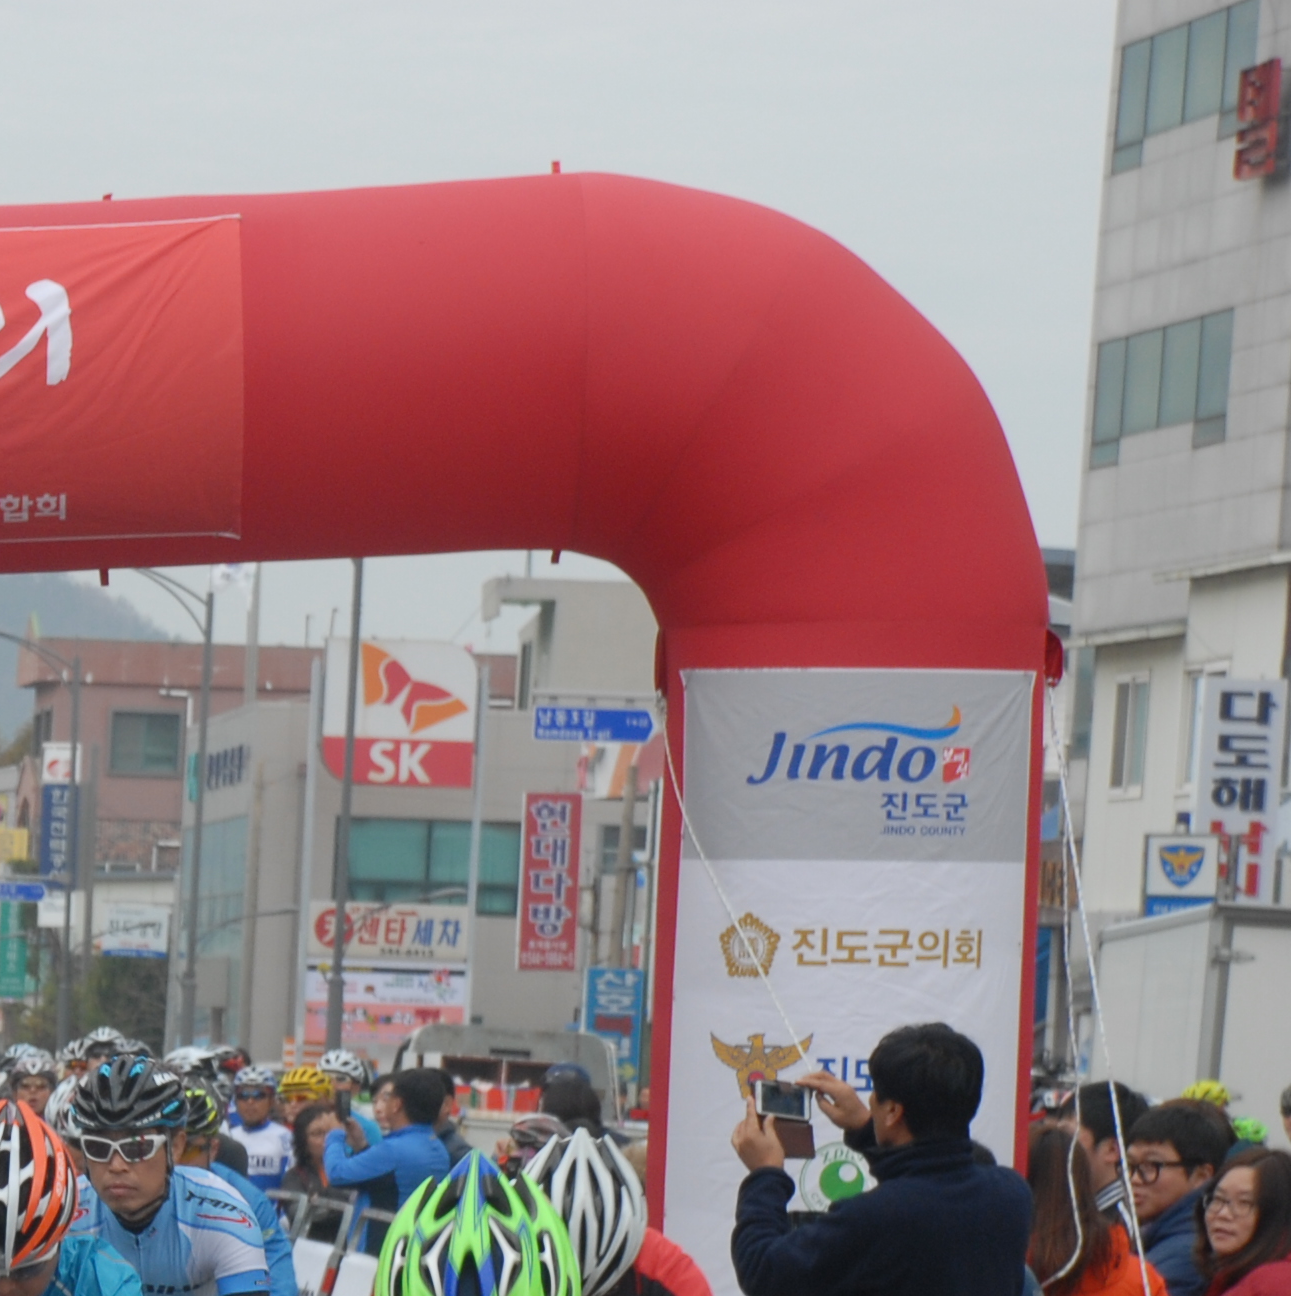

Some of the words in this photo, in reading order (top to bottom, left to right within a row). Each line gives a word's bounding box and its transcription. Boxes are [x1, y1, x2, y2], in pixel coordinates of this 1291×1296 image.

[368, 740, 432, 784] SK
[746, 731, 936, 785] Jindo
[1213, 690, 1279, 814] 다도해
[881, 791, 968, 822] 진도군
[880, 826, 915, 836] JINDO
[921, 826, 966, 837] COUNTY
[531, 801, 572, 938] 현대다방
[792, 927, 982, 968] 진도군의회
